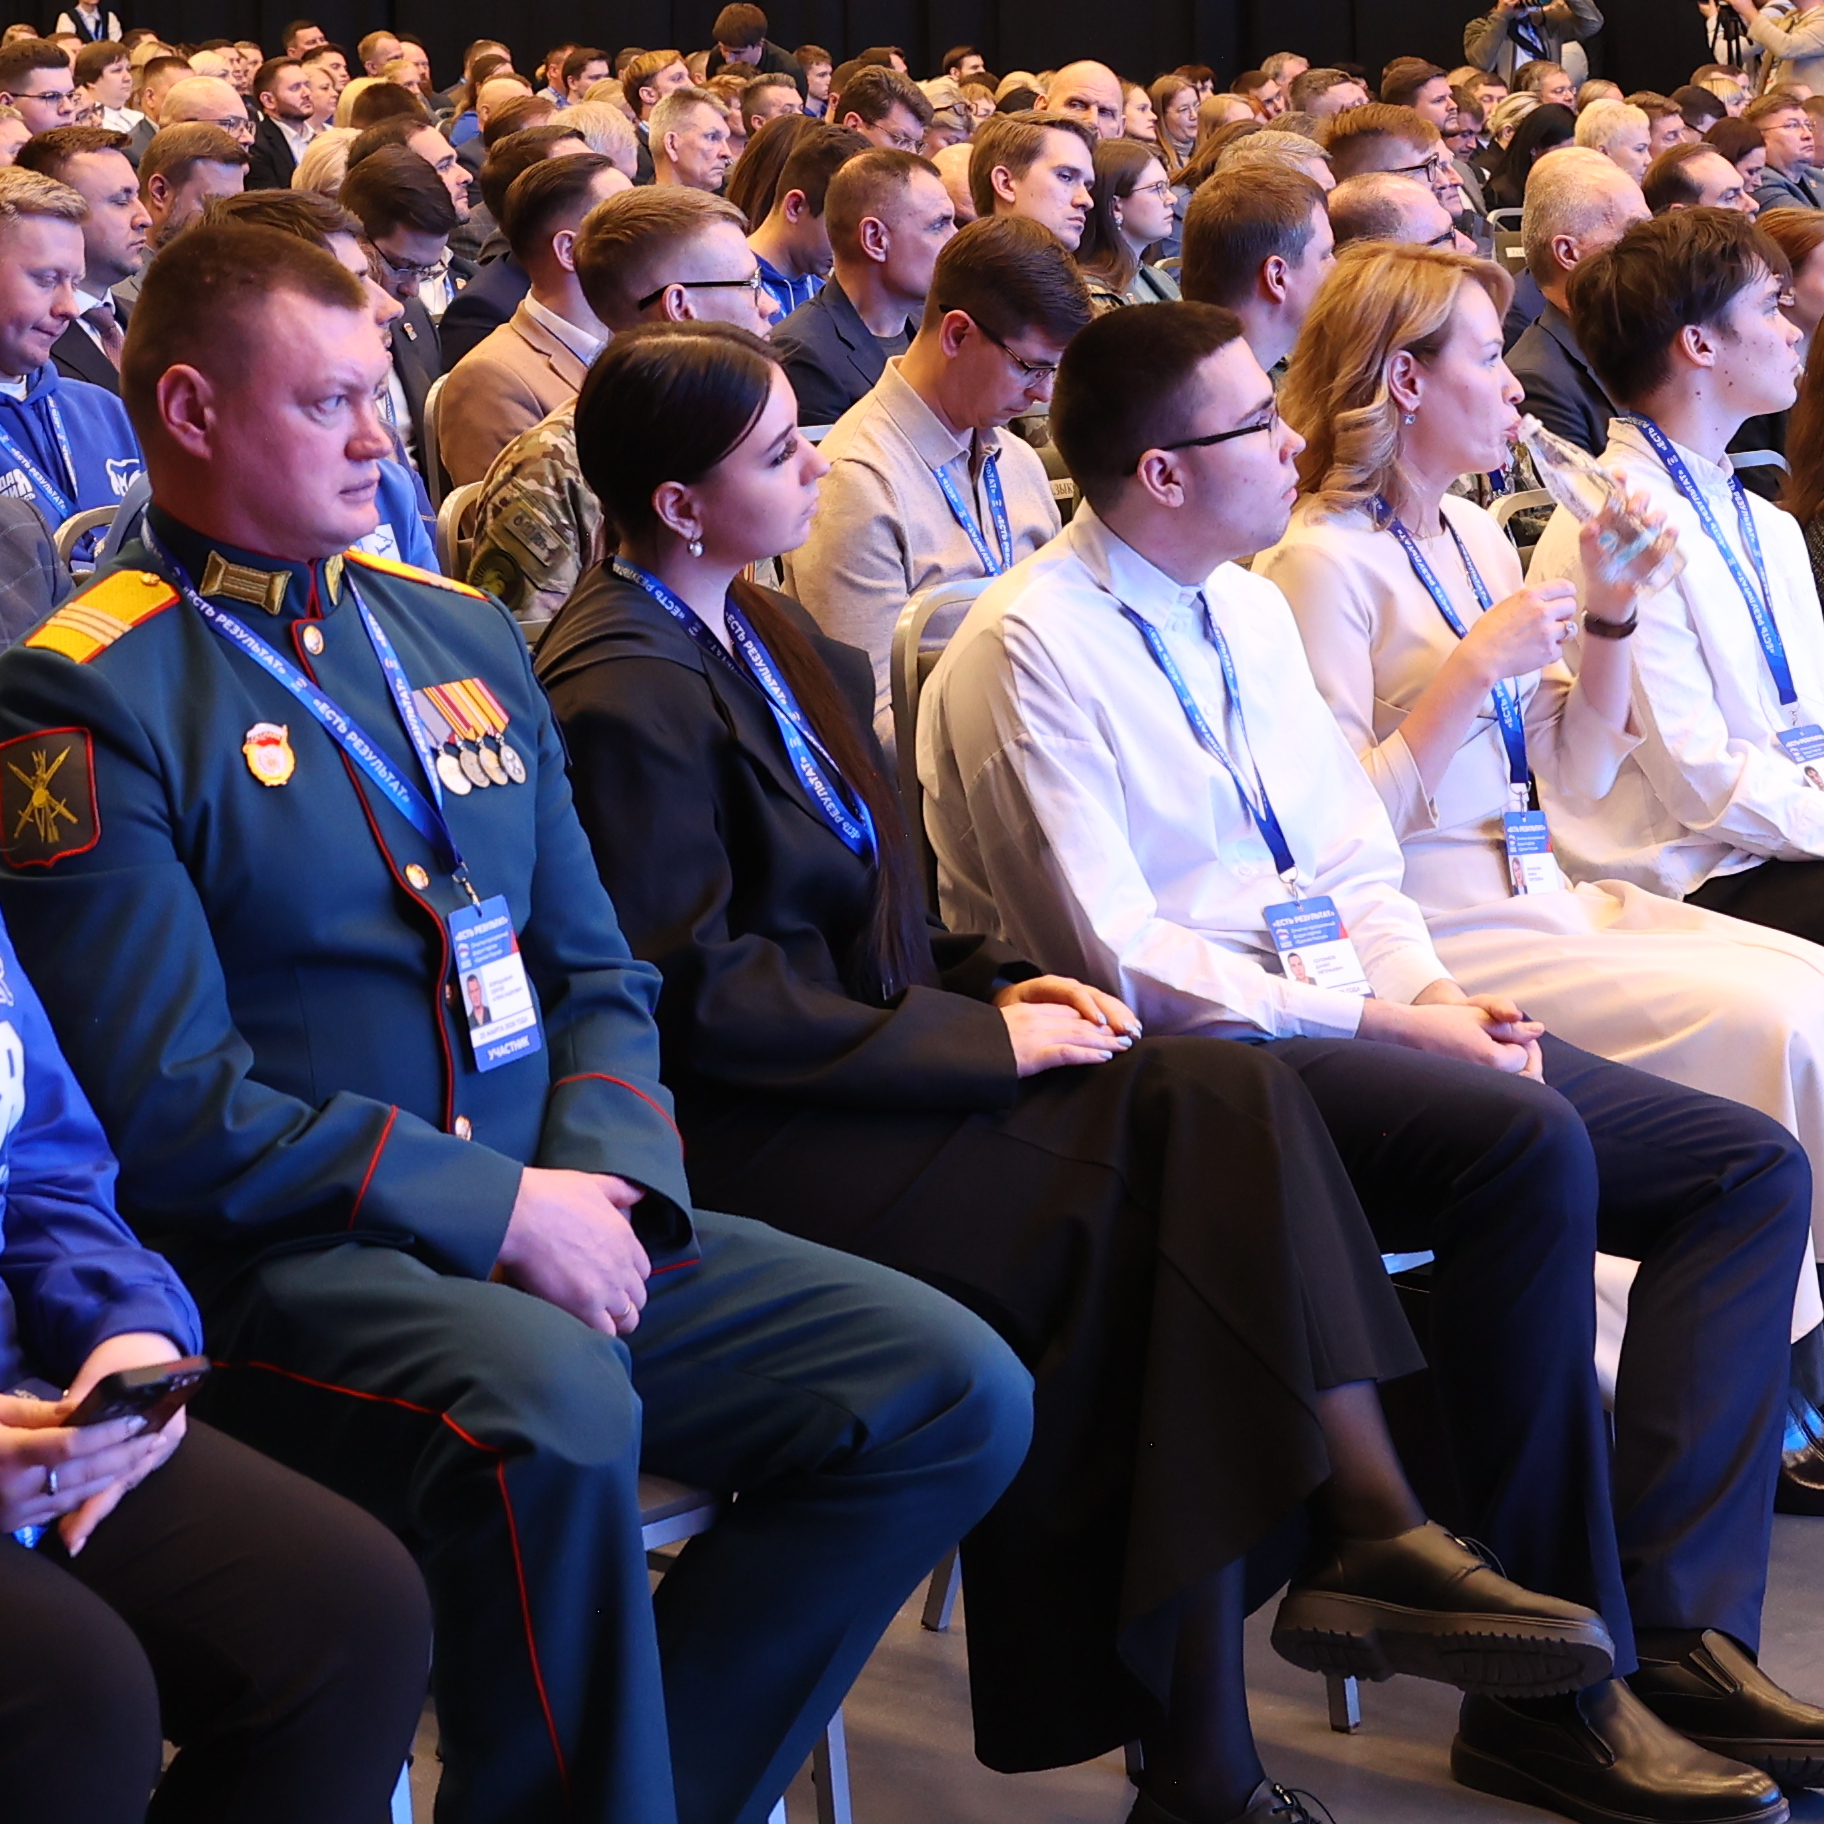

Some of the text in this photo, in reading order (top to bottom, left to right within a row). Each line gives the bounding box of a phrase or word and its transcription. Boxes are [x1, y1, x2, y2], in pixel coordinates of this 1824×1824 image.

[182, 584, 289, 676] «ЕСТЬ РЕЗУЛЬТАТ»
[654, 589, 686, 620] «ЕСТЬ
[742, 640, 789, 706] РЕЗУЛЬТАТ»
[311, 697, 412, 804] «ЕСТЬ РЕЗУЛЬТАТ»
[799, 755, 845, 825] РЕЗУЛЬТАТ»
